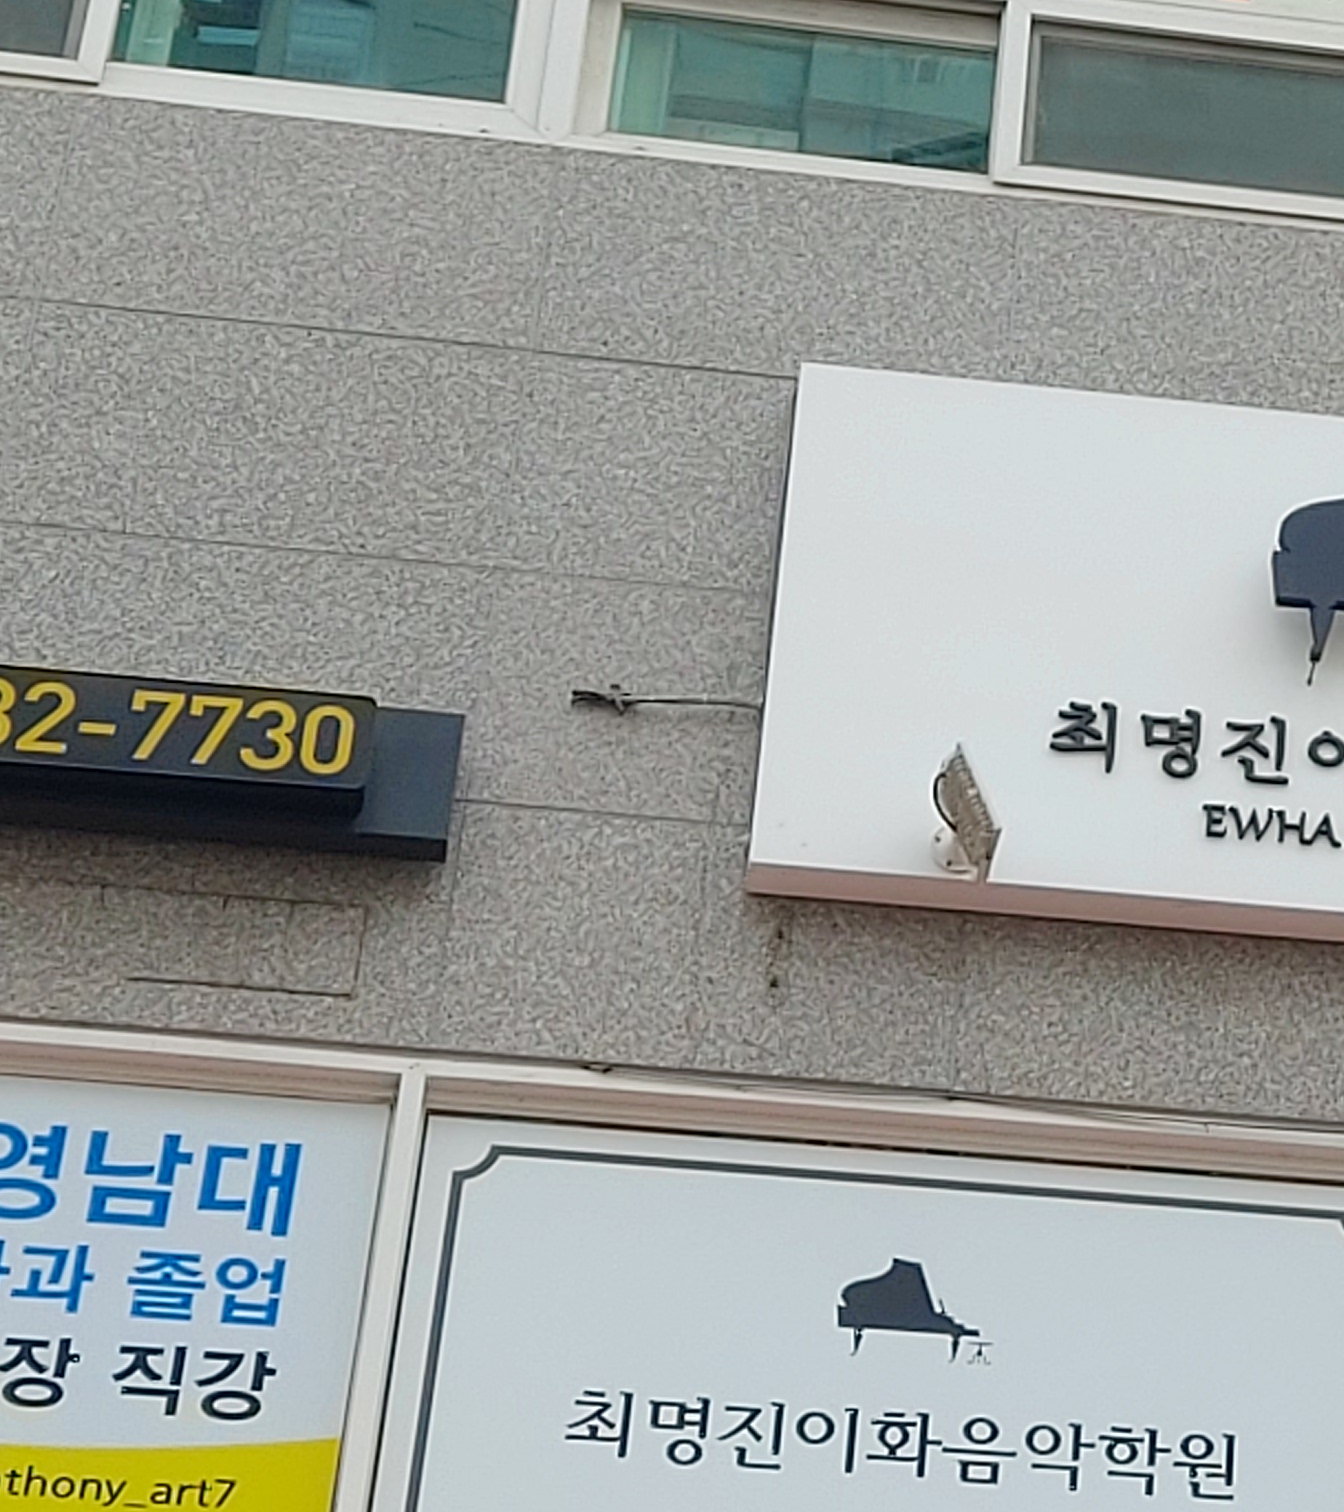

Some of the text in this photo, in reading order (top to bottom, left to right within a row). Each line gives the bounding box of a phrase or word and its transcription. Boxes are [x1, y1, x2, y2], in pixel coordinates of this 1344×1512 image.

[1202, 803, 1342, 849] EWHA
[0, 1122, 303, 1238] 영남대
[0, 1240, 287, 1327] 과 졸업
[112, 1345, 278, 1421] 직강
[564, 1387, 1239, 1502] 최명진이화음악학원
[0, 1465, 237, 1510] thony_art7
